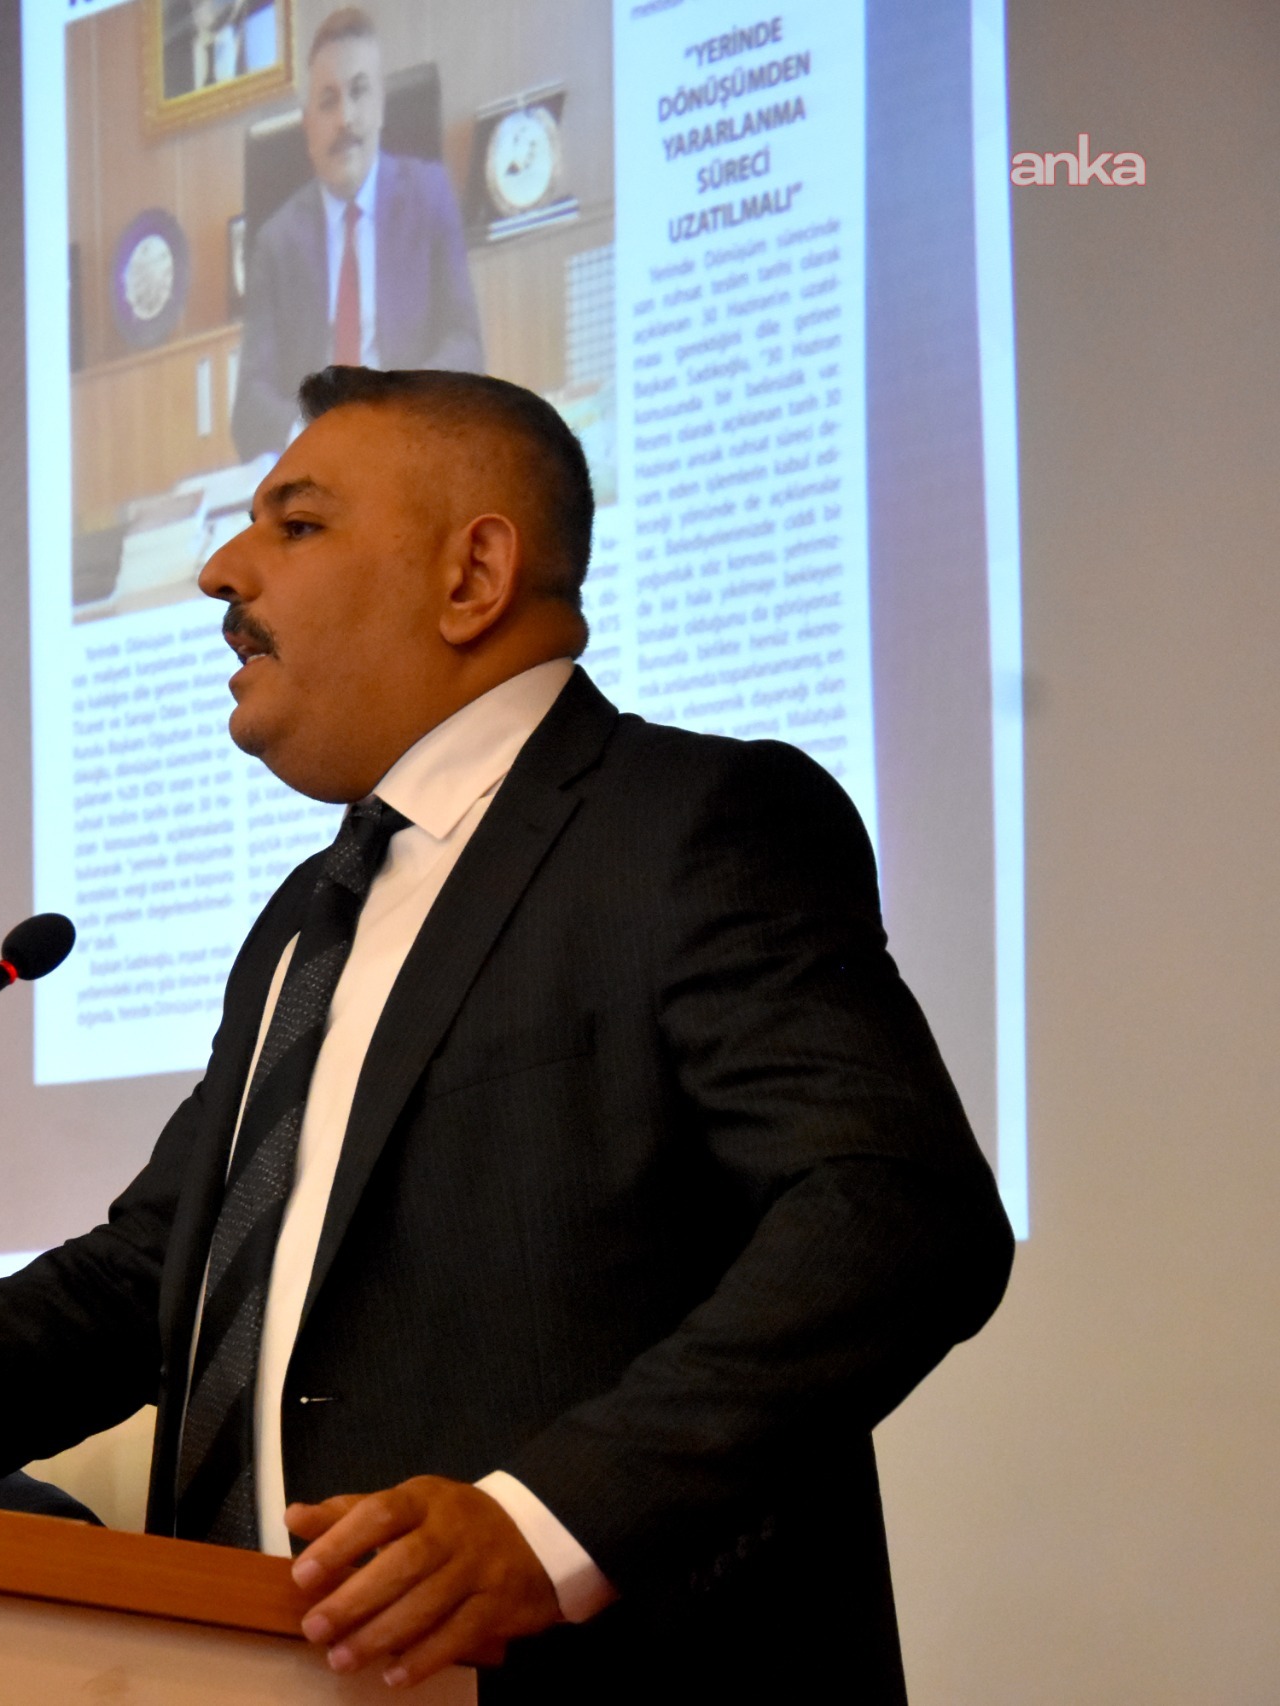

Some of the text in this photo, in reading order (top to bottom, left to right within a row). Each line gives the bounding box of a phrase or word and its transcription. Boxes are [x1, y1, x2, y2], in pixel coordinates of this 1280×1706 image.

[658, 50, 811, 122] DÖNÜŞÜMDEN
[663, 96, 806, 161] YARARLANMA
[697, 145, 771, 194] SÜRECİ
